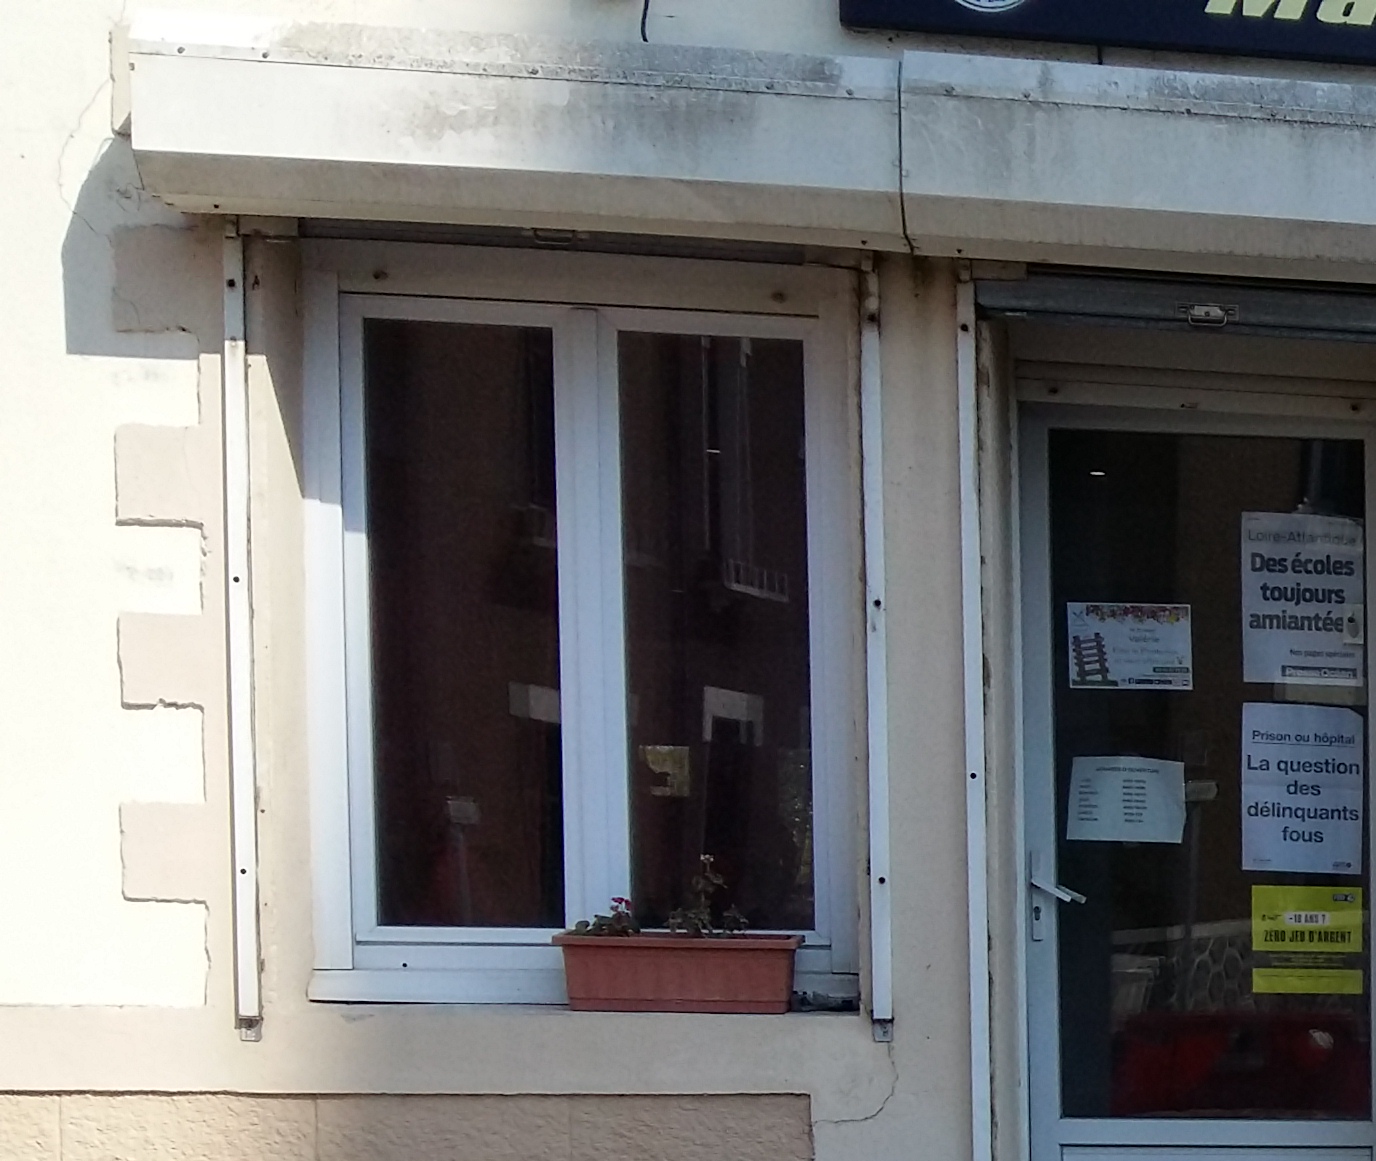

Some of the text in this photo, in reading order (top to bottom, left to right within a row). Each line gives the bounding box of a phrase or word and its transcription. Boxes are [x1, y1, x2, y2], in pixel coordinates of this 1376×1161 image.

[1251, 552, 1355, 576] Des écoles
[1260, 582, 1345, 606] toujours
[1249, 610, 1343, 633] amiantée
[1252, 730, 1355, 746] Prison ou hôpital
[1247, 754, 1360, 775] La question
[1286, 780, 1321, 796] des
[1247, 801, 1359, 822] délinquants
[1281, 826, 1324, 843] fous
[1304, 914, 1319, 923] ANS
[1289, 930, 1305, 943] JEU
